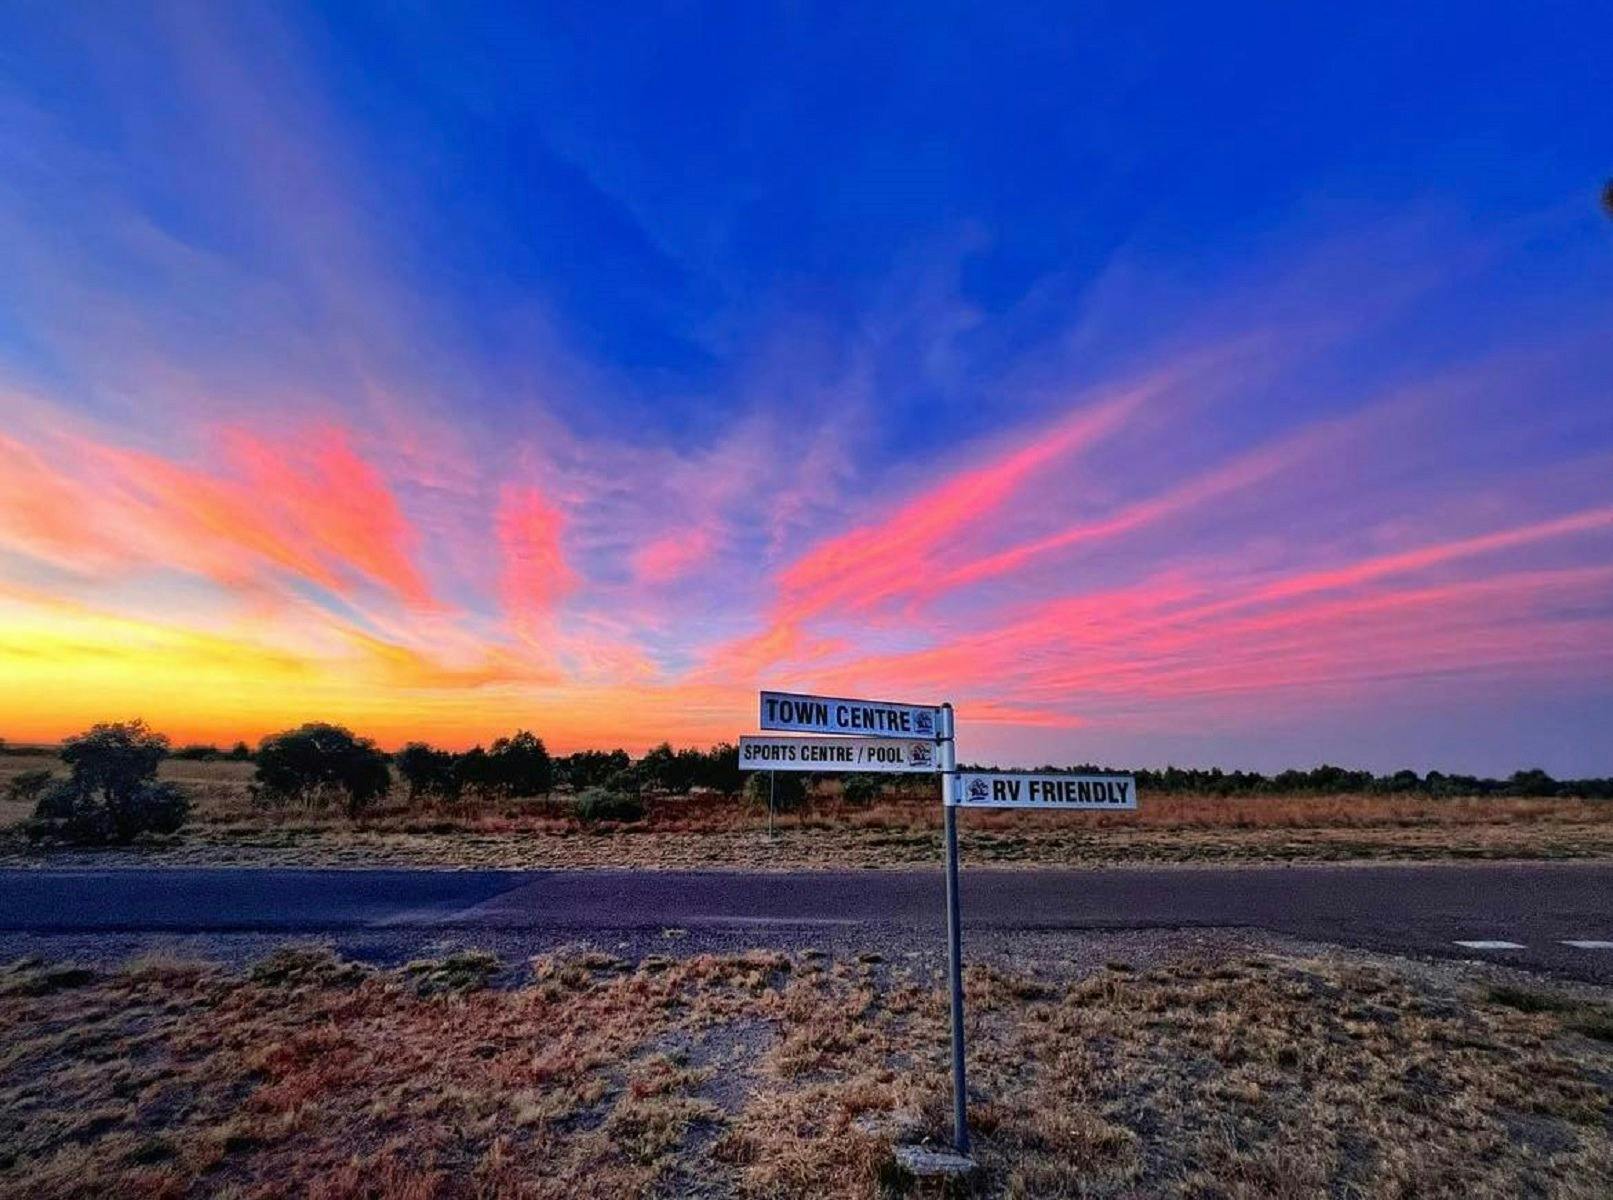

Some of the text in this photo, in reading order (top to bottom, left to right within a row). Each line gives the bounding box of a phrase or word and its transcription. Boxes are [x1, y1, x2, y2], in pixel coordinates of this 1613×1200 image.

[766, 699, 911, 732] TOWN CENTRE
[744, 744, 904, 764] SPORTS CENTRE / POOL
[992, 780, 1129, 804] RV FRIENDLY
